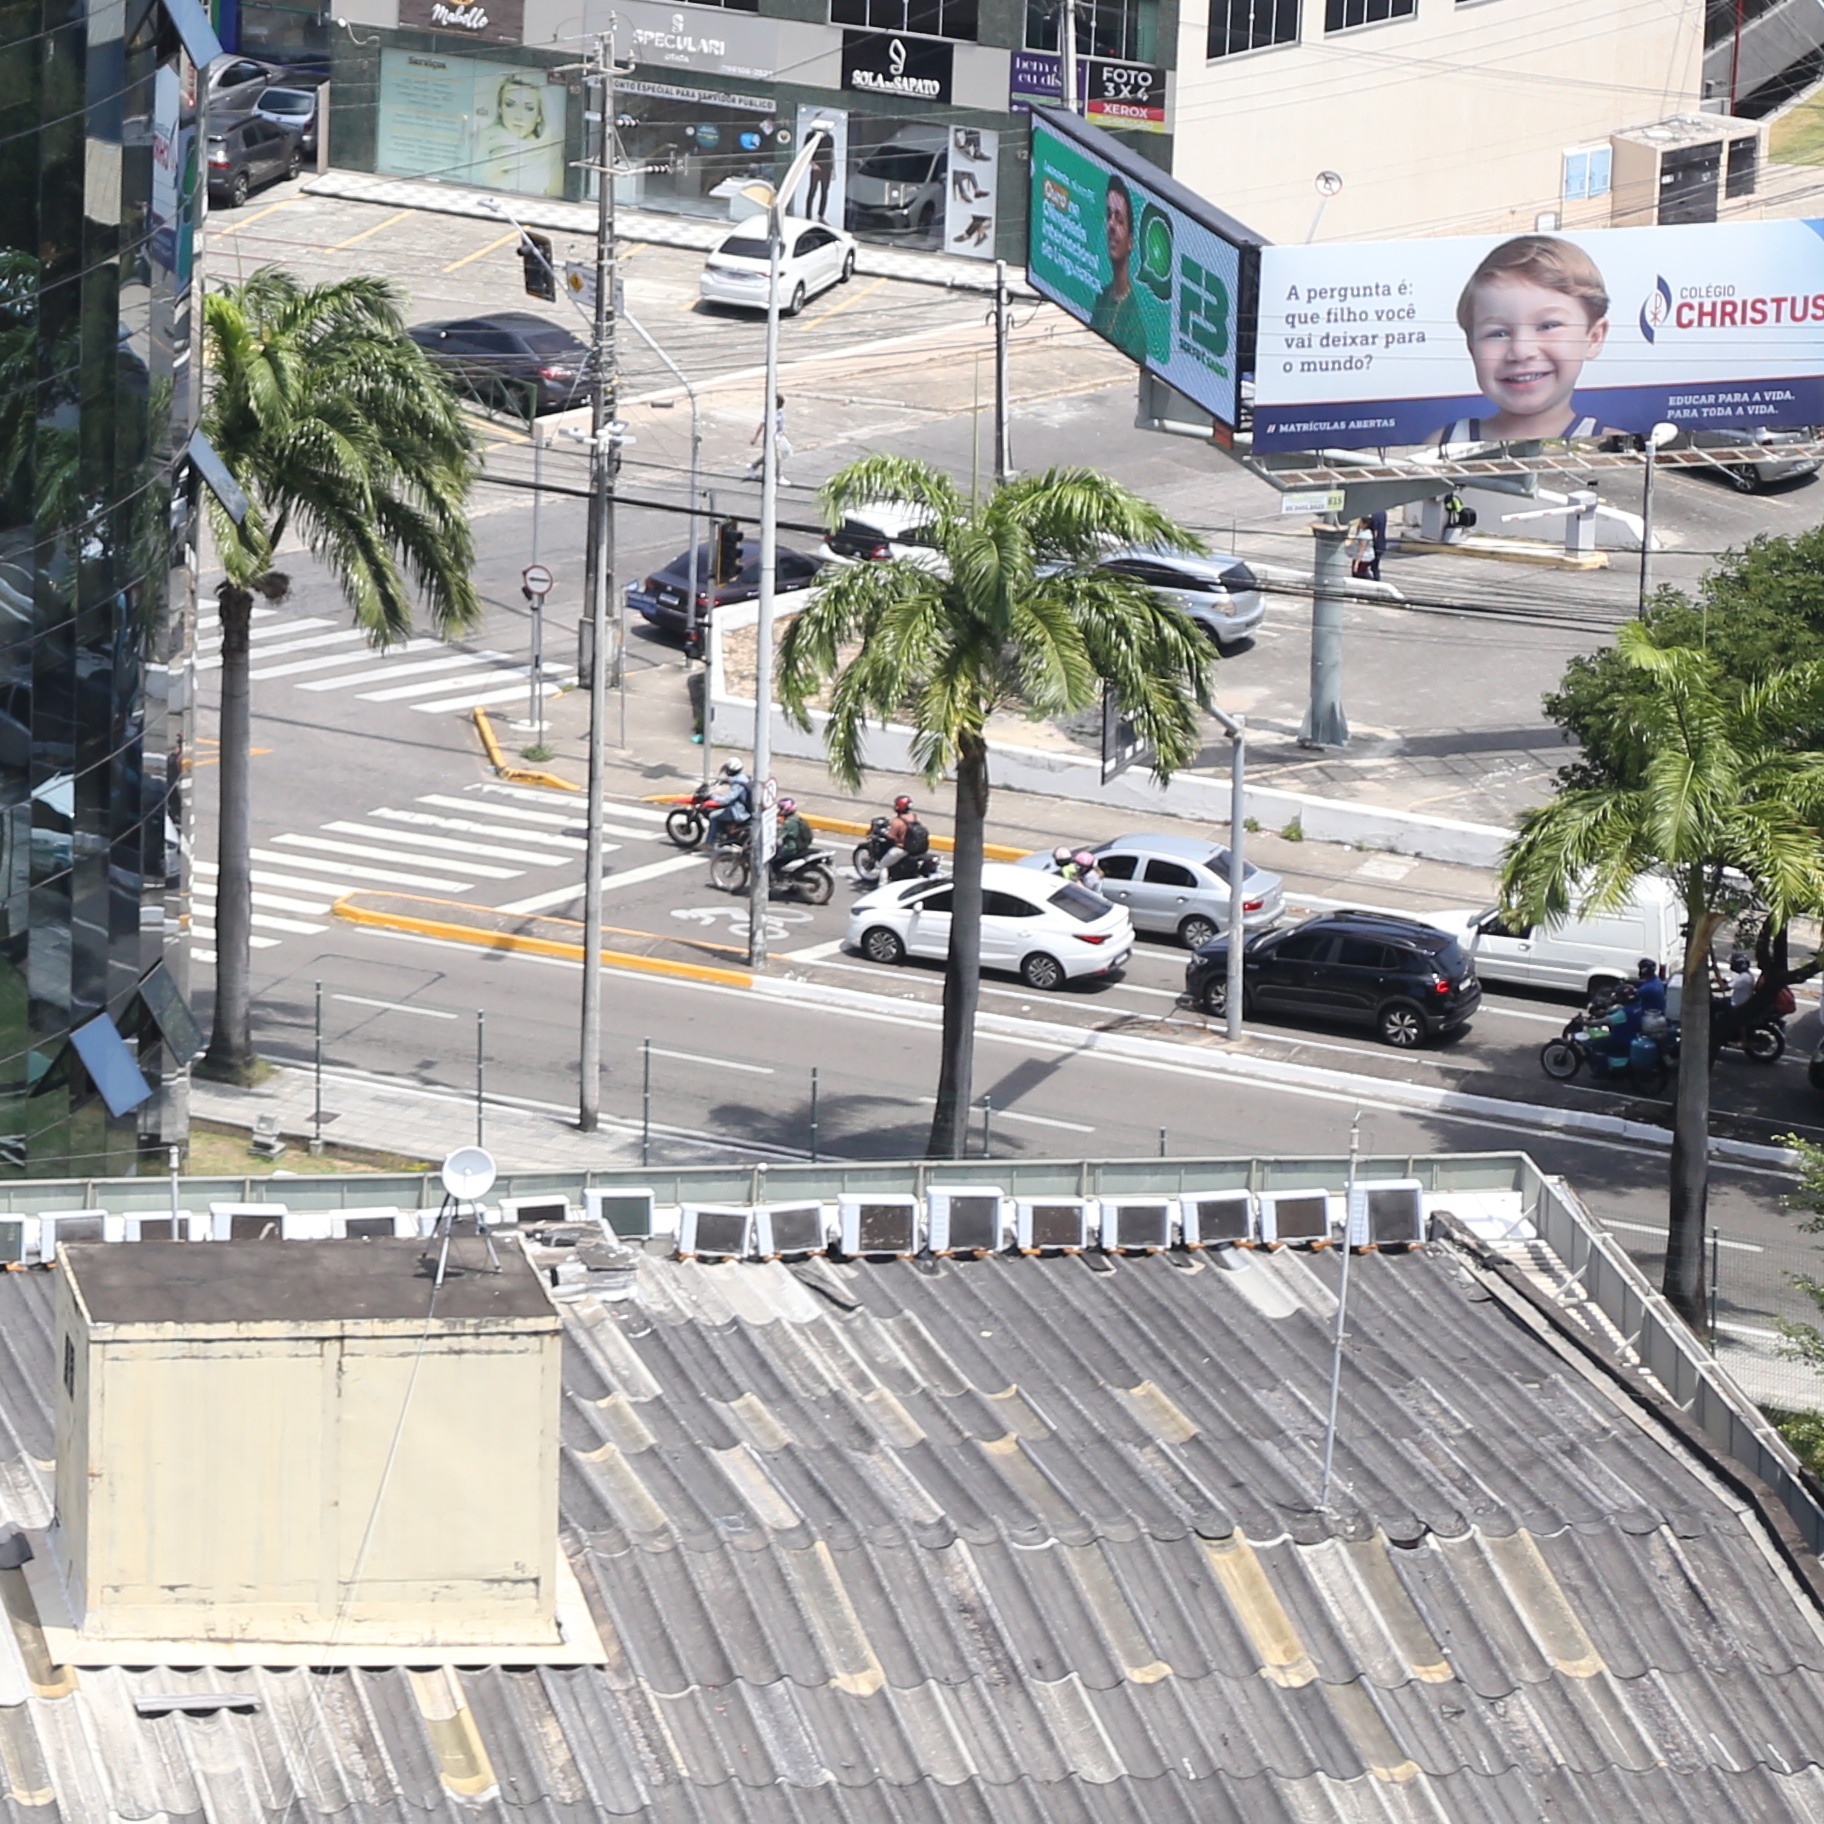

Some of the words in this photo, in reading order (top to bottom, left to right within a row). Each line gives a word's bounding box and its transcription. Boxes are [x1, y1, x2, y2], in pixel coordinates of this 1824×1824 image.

[633, 29, 725, 56] SPECULARI
[851, 69, 884, 88] SOLA
[893, 76, 940, 95] SAPATO
[1102, 67, 1153, 87] FOTO
[637, 82, 674, 96] ESPECIAL
[676, 88, 696, 100] PARA
[698, 91, 737, 105] SERVIDOR
[1104, 82, 1115, 97] 3
[1119, 84, 1132, 99] X
[1137, 87, 1149, 102] 4
[1103, 103, 1148, 119] XEROX
[1286, 284, 1300, 301] A
[1306, 282, 1391, 304] pergunta
[1397, 279, 1413, 296] é:
[1680, 283, 1736, 300] COLÉGIO
[1285, 311, 1320, 329] que
[1326, 307, 1368, 324] filho
[1374, 304, 1416, 321] você
[1675, 294, 1824, 329] CHRISTUS
[1285, 333, 1312, 349] vai
[1319, 332, 1379, 349] deixar
[1384, 330, 1426, 349] para
[1283, 361, 1293, 373] o
[1300, 354, 1373, 373] mundo?
[1669, 394, 1715, 406] EDUCAR
[1718, 393, 1749, 404] PARA
[1752, 392, 1761, 402] A
[1764, 390, 1796, 401] VIDA.
[1667, 408, 1699, 420] PARA
[1702, 406, 1732, 417] TODA
[1736, 406, 1745, 416] A
[1747, 404, 1778, 415] VIDA.
[1279, 420, 1347, 433] MATRÍCULAS
[1349, 418, 1395, 430] ABERTAS
